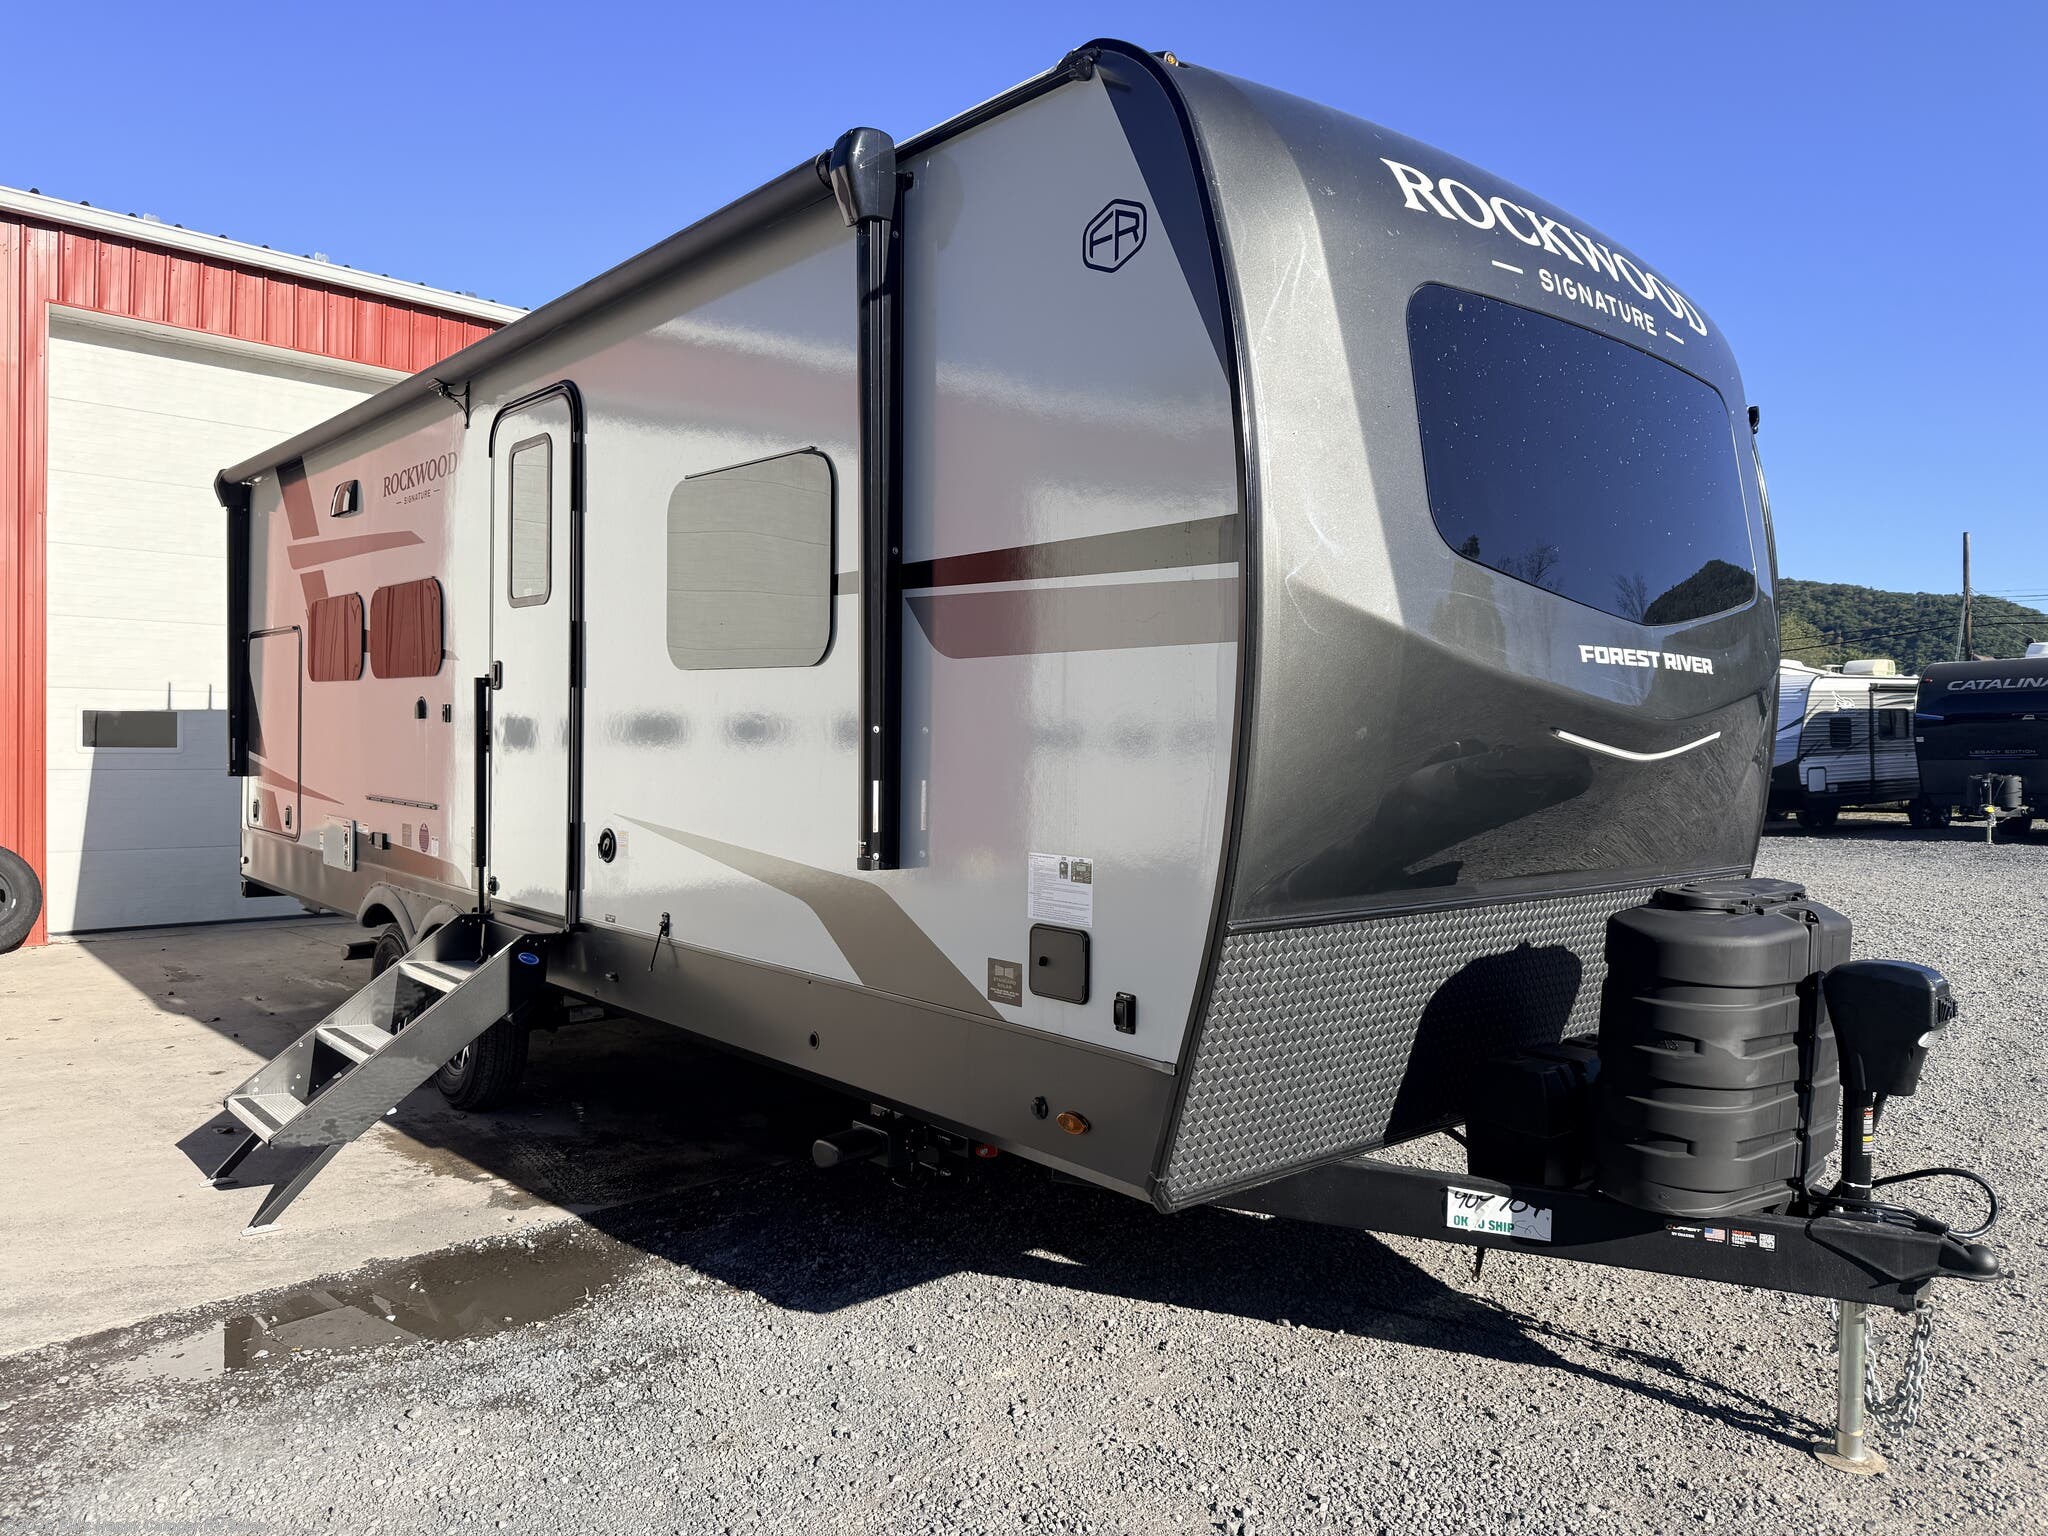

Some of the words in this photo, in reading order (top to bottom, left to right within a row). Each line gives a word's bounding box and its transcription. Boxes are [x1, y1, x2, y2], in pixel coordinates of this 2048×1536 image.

[1380, 157, 1707, 337] ROCKWOOD
[1538, 268, 1658, 337] SIGNATURE
[383, 451, 458, 497] ROCKWOOD
[403, 489, 431, 505] SIGNATURE
[1578, 645, 1660, 669] FOREST
[1662, 652, 1714, 675] RIVER
[1453, 1215, 1469, 1227] OK
[1488, 1220, 1515, 1233] SHIP
